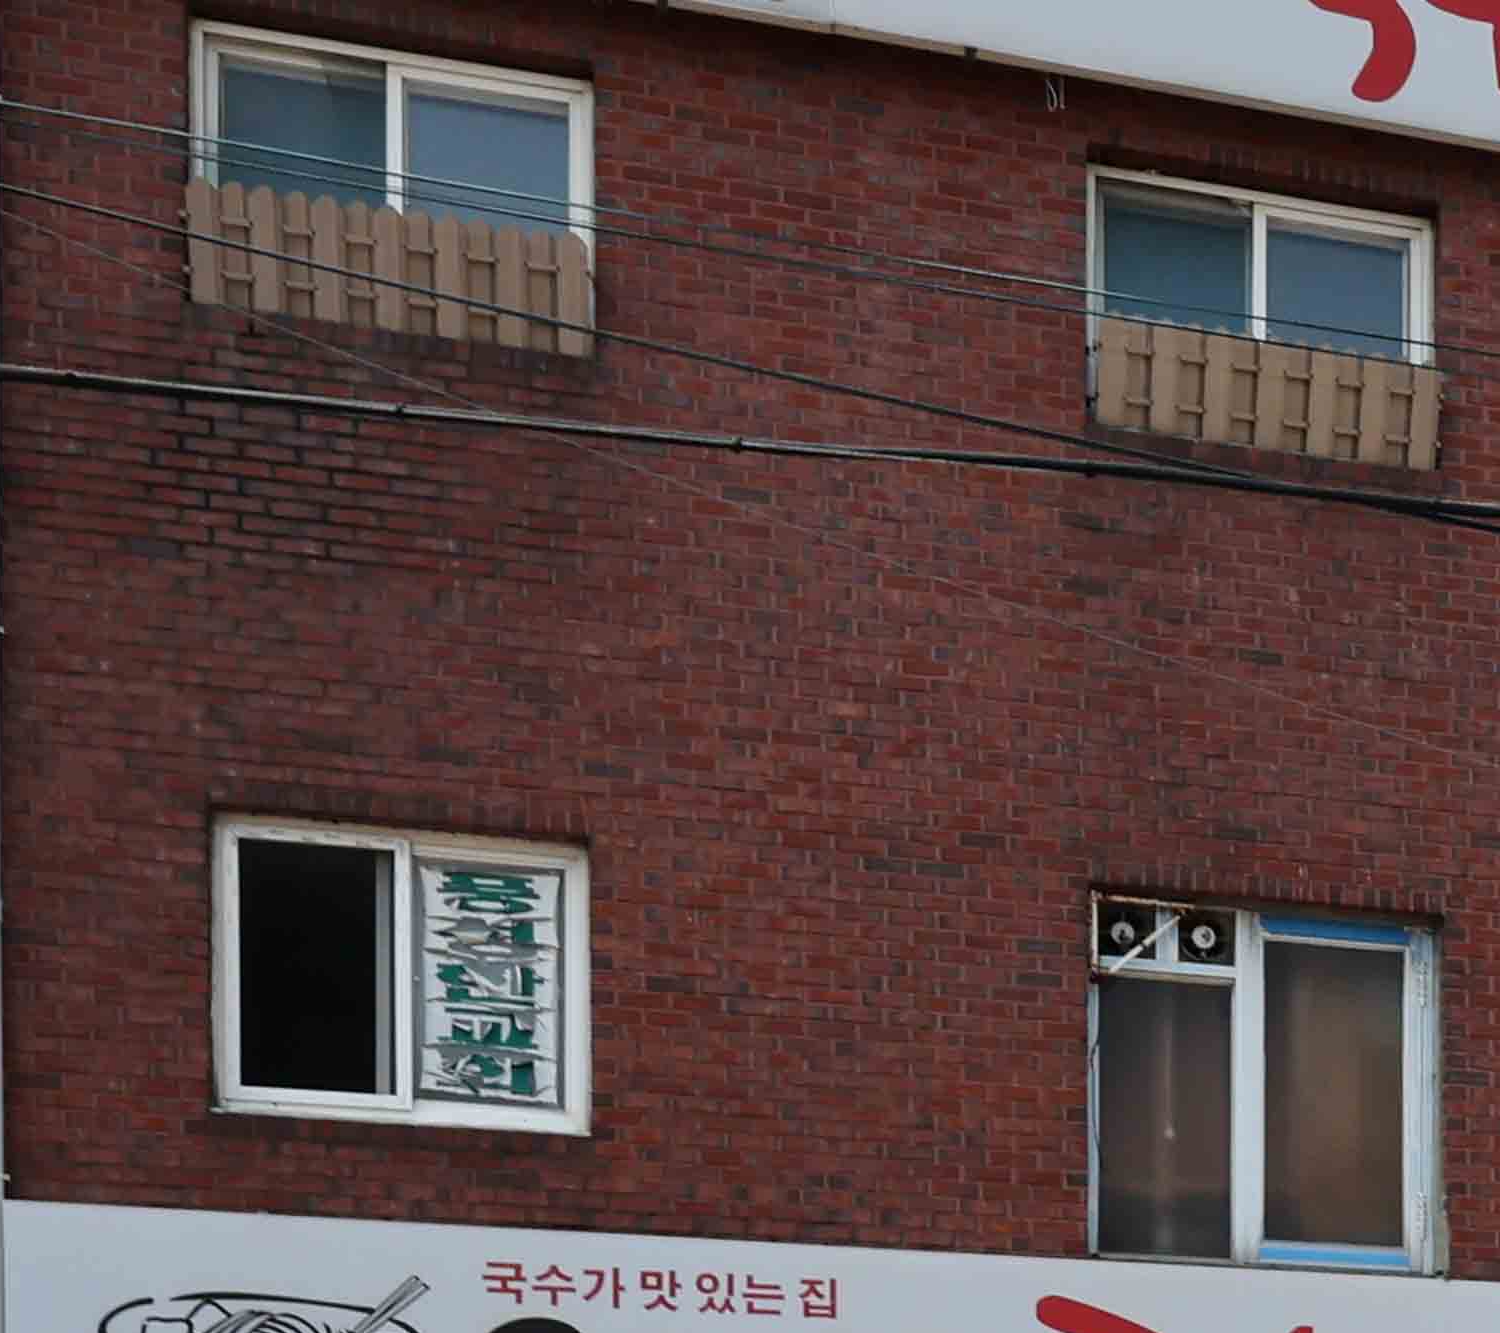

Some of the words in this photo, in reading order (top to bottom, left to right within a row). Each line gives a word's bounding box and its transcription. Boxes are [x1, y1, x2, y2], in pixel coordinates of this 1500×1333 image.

[482, 1260, 625, 1309] 국수가
[640, 1267, 683, 1313] 맛
[695, 1271, 786, 1317] 있는
[798, 1276, 840, 1320] 집
